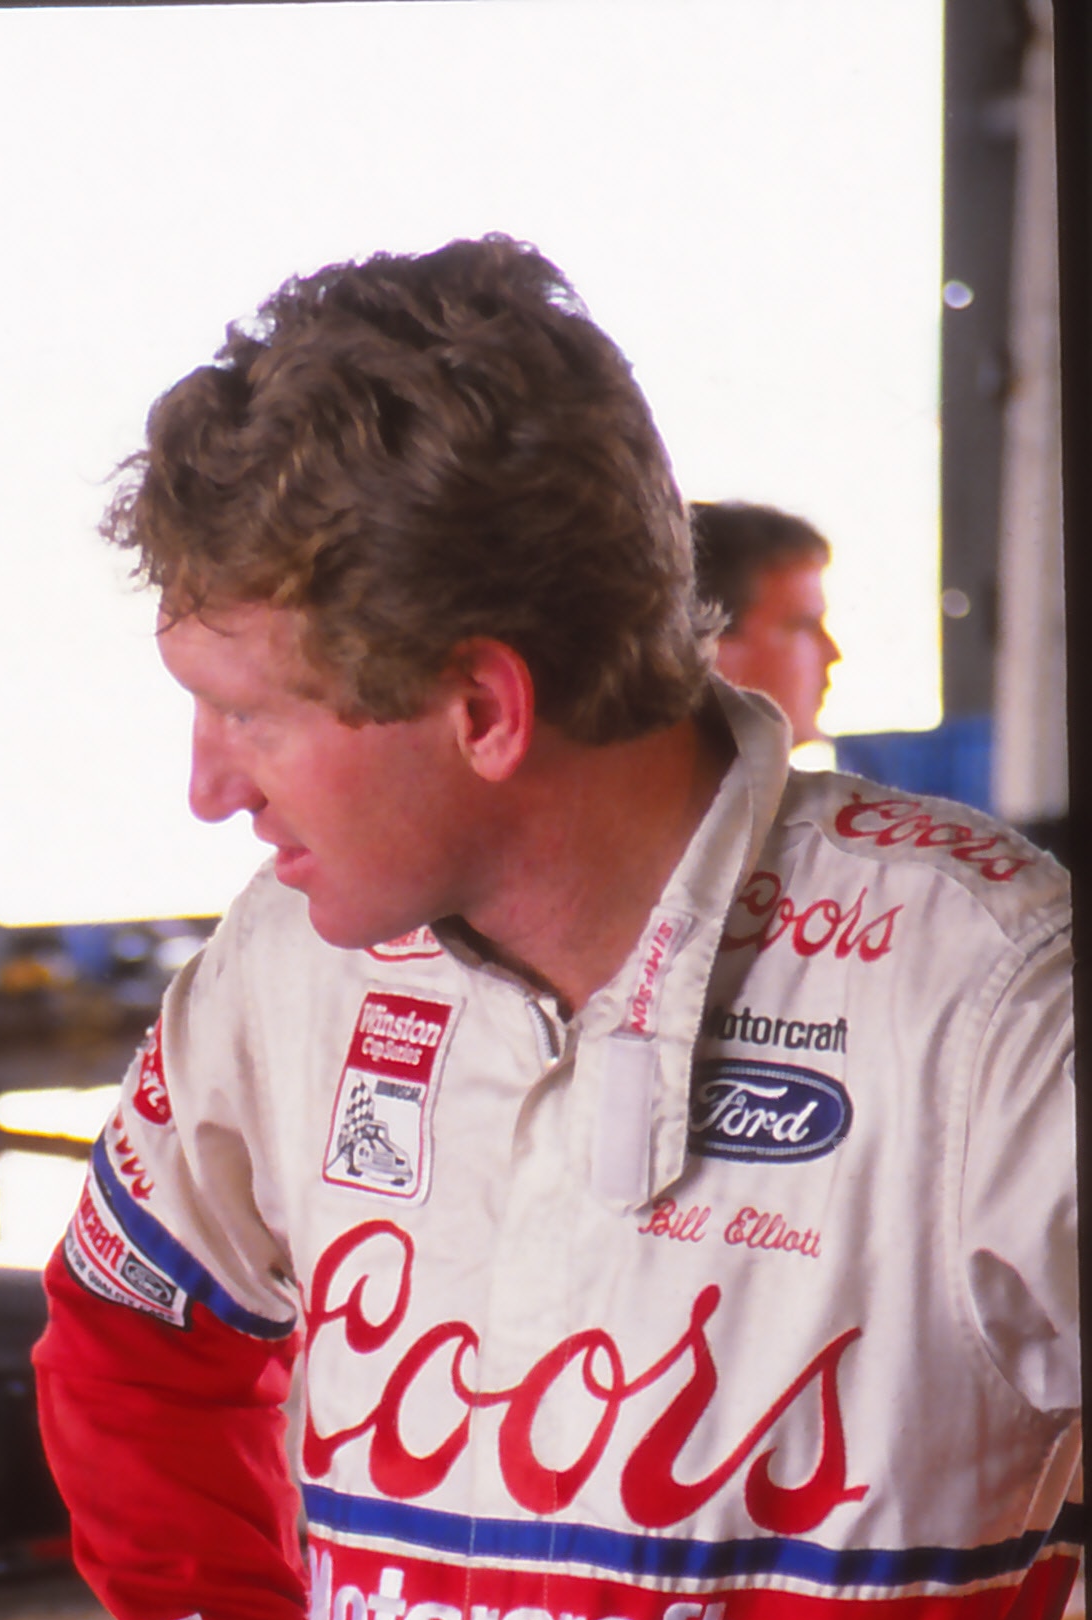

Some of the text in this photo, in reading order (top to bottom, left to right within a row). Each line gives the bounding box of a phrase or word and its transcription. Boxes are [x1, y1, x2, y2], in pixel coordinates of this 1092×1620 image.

[834, 791, 1032, 882] Coors
[719, 870, 904, 963] Coors
[359, 1002, 442, 1047] Winston
[692, 1078, 819, 1143] Ford
[638, 1196, 712, 1242] Bill
[302, 1220, 870, 1535] Coors
